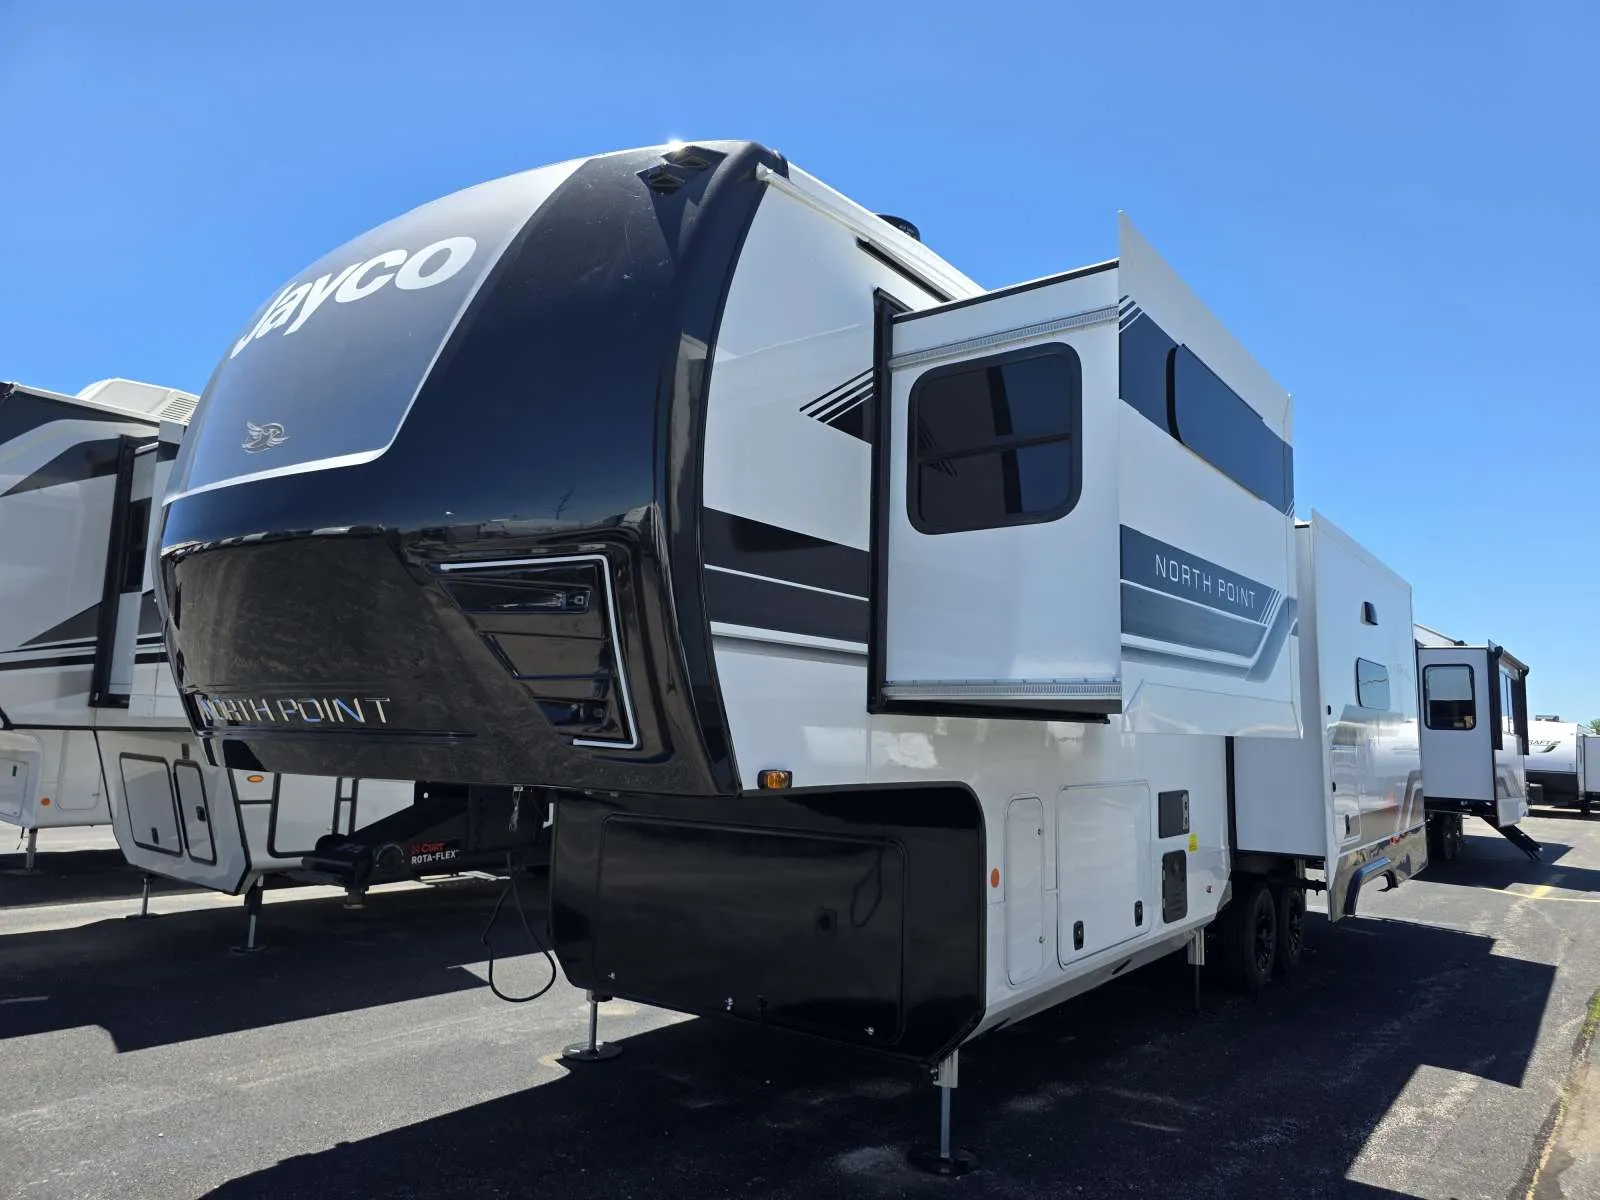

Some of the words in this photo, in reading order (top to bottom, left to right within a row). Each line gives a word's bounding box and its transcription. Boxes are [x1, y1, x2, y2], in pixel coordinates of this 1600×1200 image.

[1155, 553, 1212, 594] NORTH
[1218, 579, 1256, 609] POINT
[198, 697, 275, 723] NORTH
[276, 697, 391, 723] POINT
